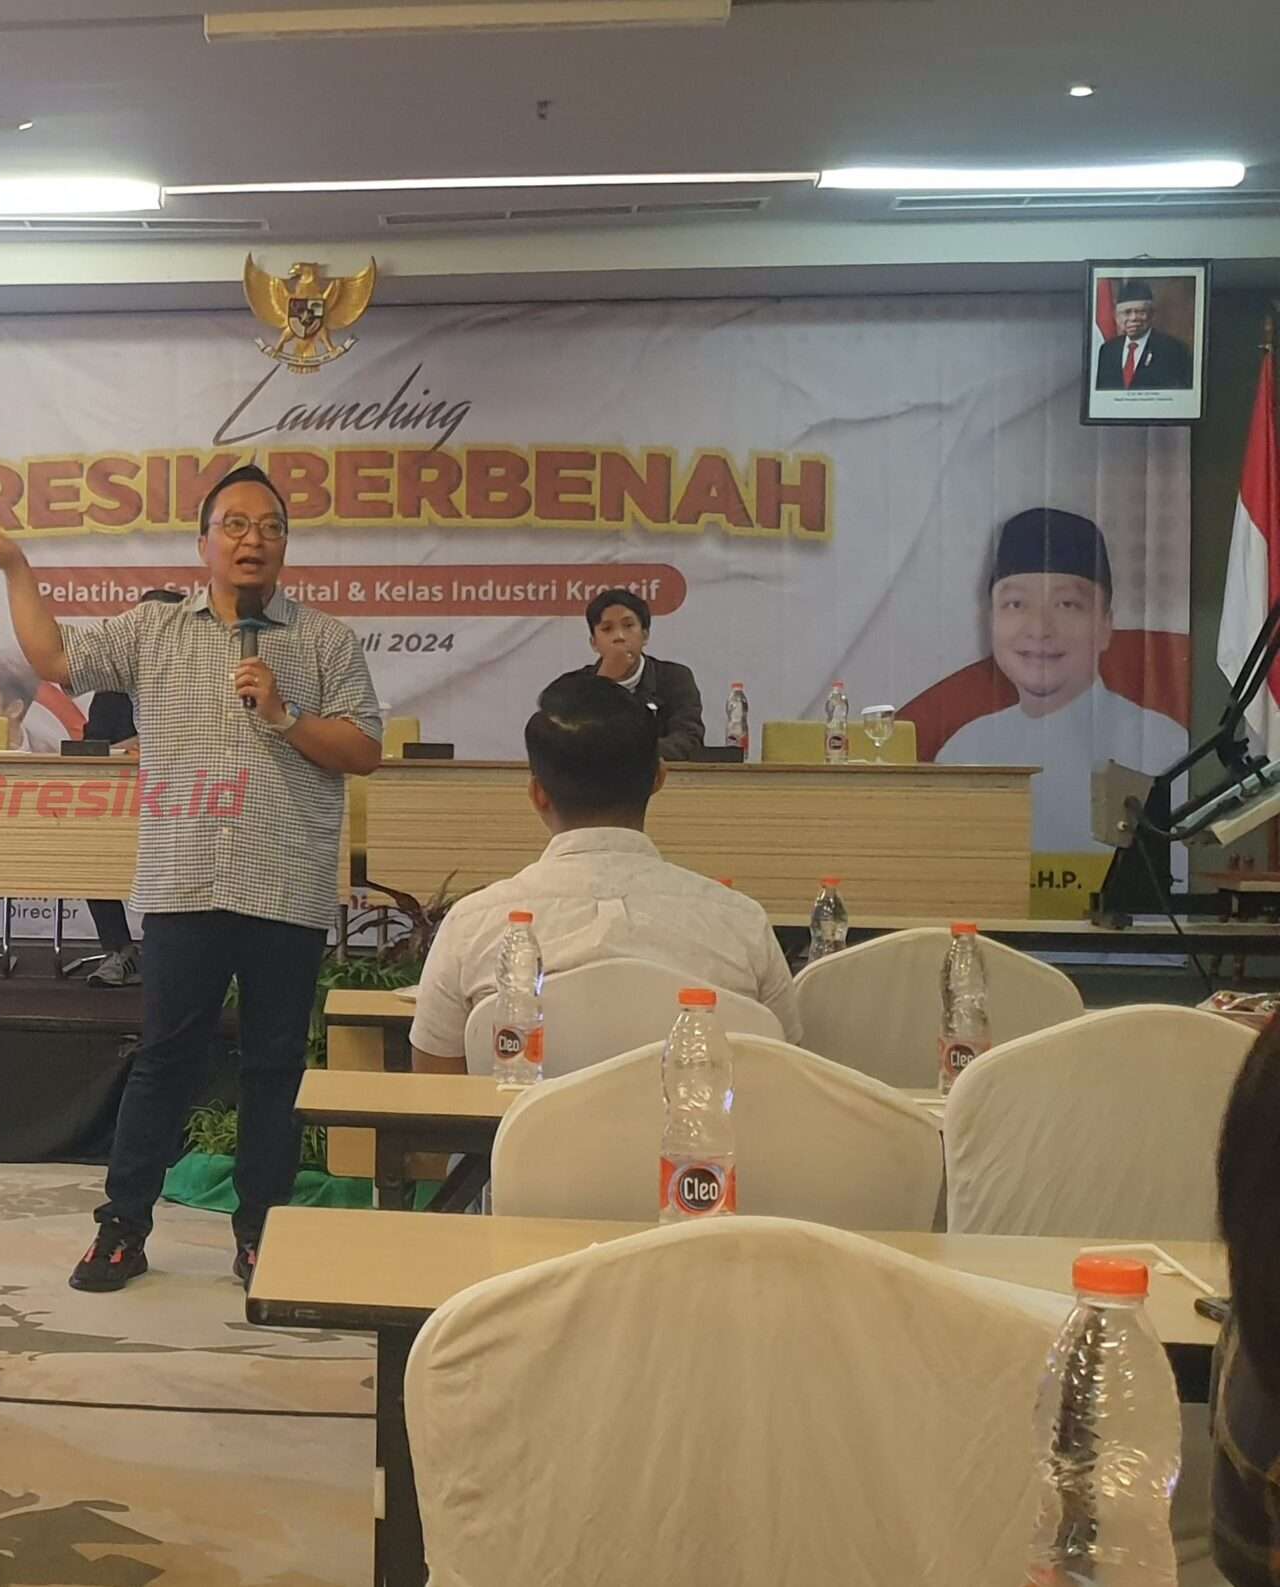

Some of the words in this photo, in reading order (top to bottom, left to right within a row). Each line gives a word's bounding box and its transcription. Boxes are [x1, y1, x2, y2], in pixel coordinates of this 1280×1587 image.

[213, 362, 473, 451] Launching
[268, 449, 828, 532] BERBENAH
[348, 581, 367, 602] &
[375, 581, 444, 602] Kelas
[452, 579, 557, 602] Industri
[566, 579, 661, 601] Krtif
[387, 633, 455, 653] 2024
[1030, 871, 1082, 889] .H.P.
[7, 903, 79, 919] Direcor
[683, 1177, 719, 1201] Cleo
